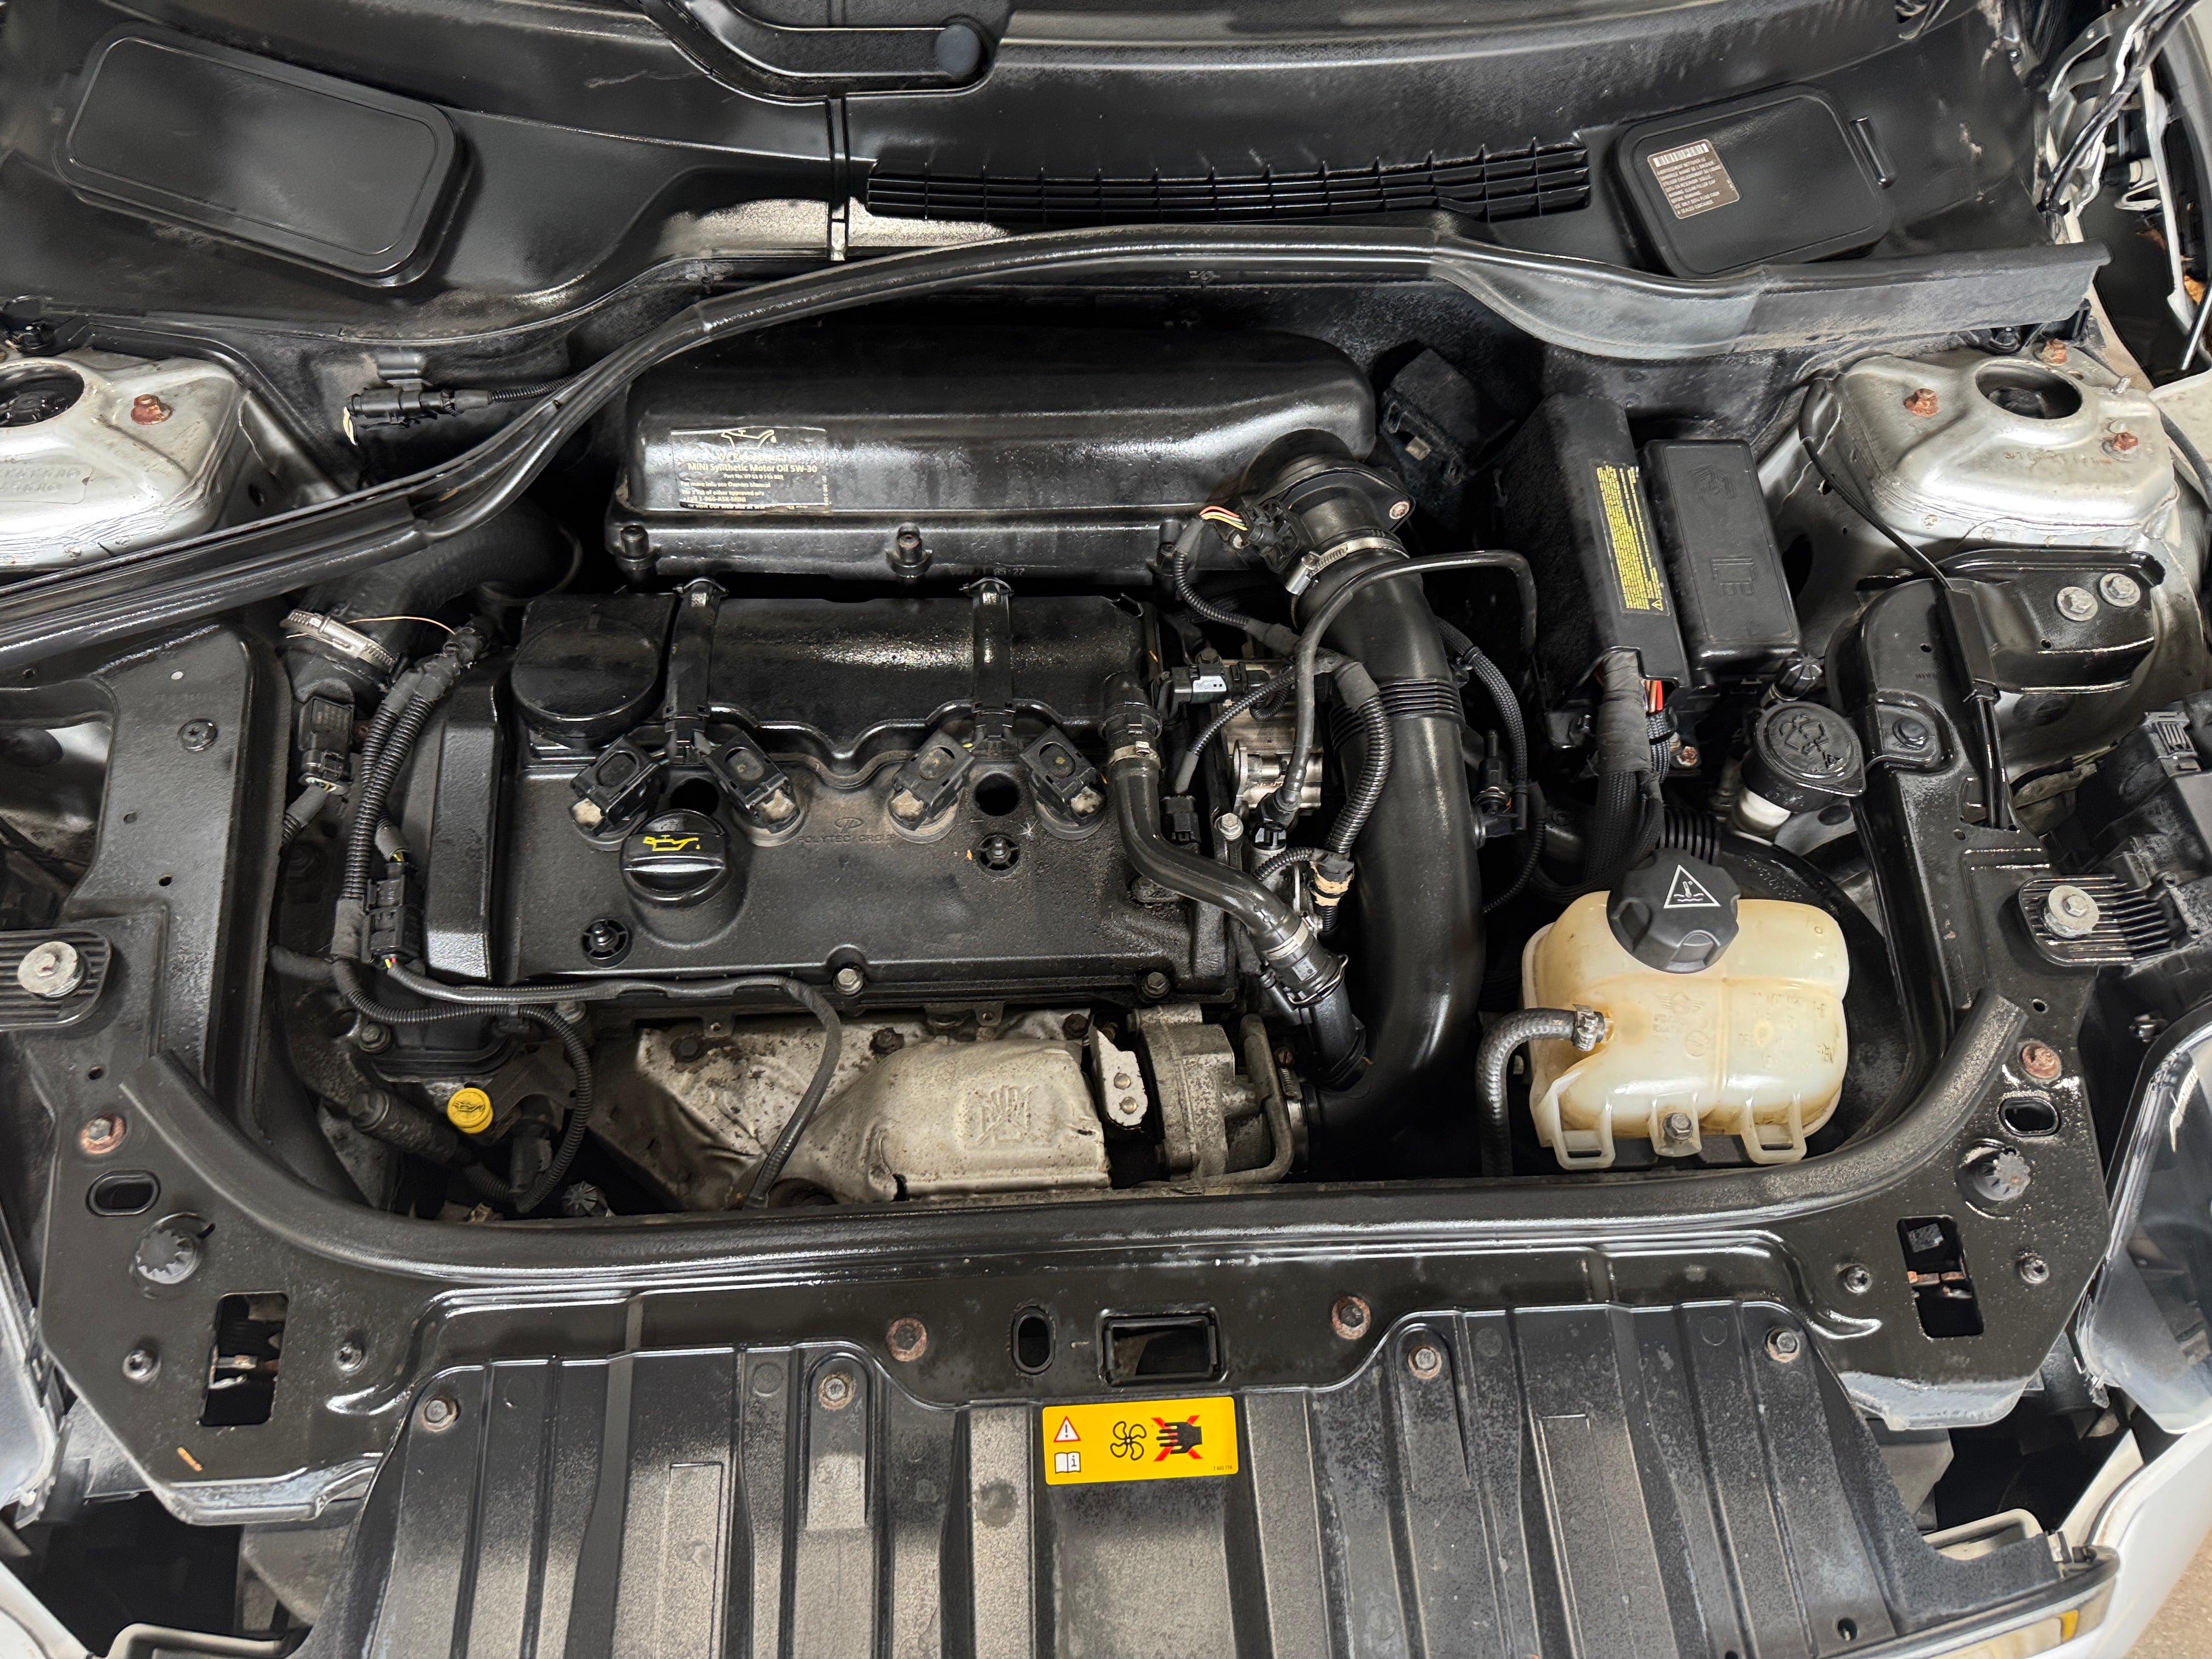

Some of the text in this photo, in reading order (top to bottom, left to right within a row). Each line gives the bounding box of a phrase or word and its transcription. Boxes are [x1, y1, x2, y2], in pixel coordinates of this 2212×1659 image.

[687, 462, 709, 471] MINI
[710, 463, 749, 472] Synthetic
[776, 464, 789, 472] Oil
[790, 465, 818, 473] 5W-30
[797, 833, 898, 844] POLYTEC GROUP
